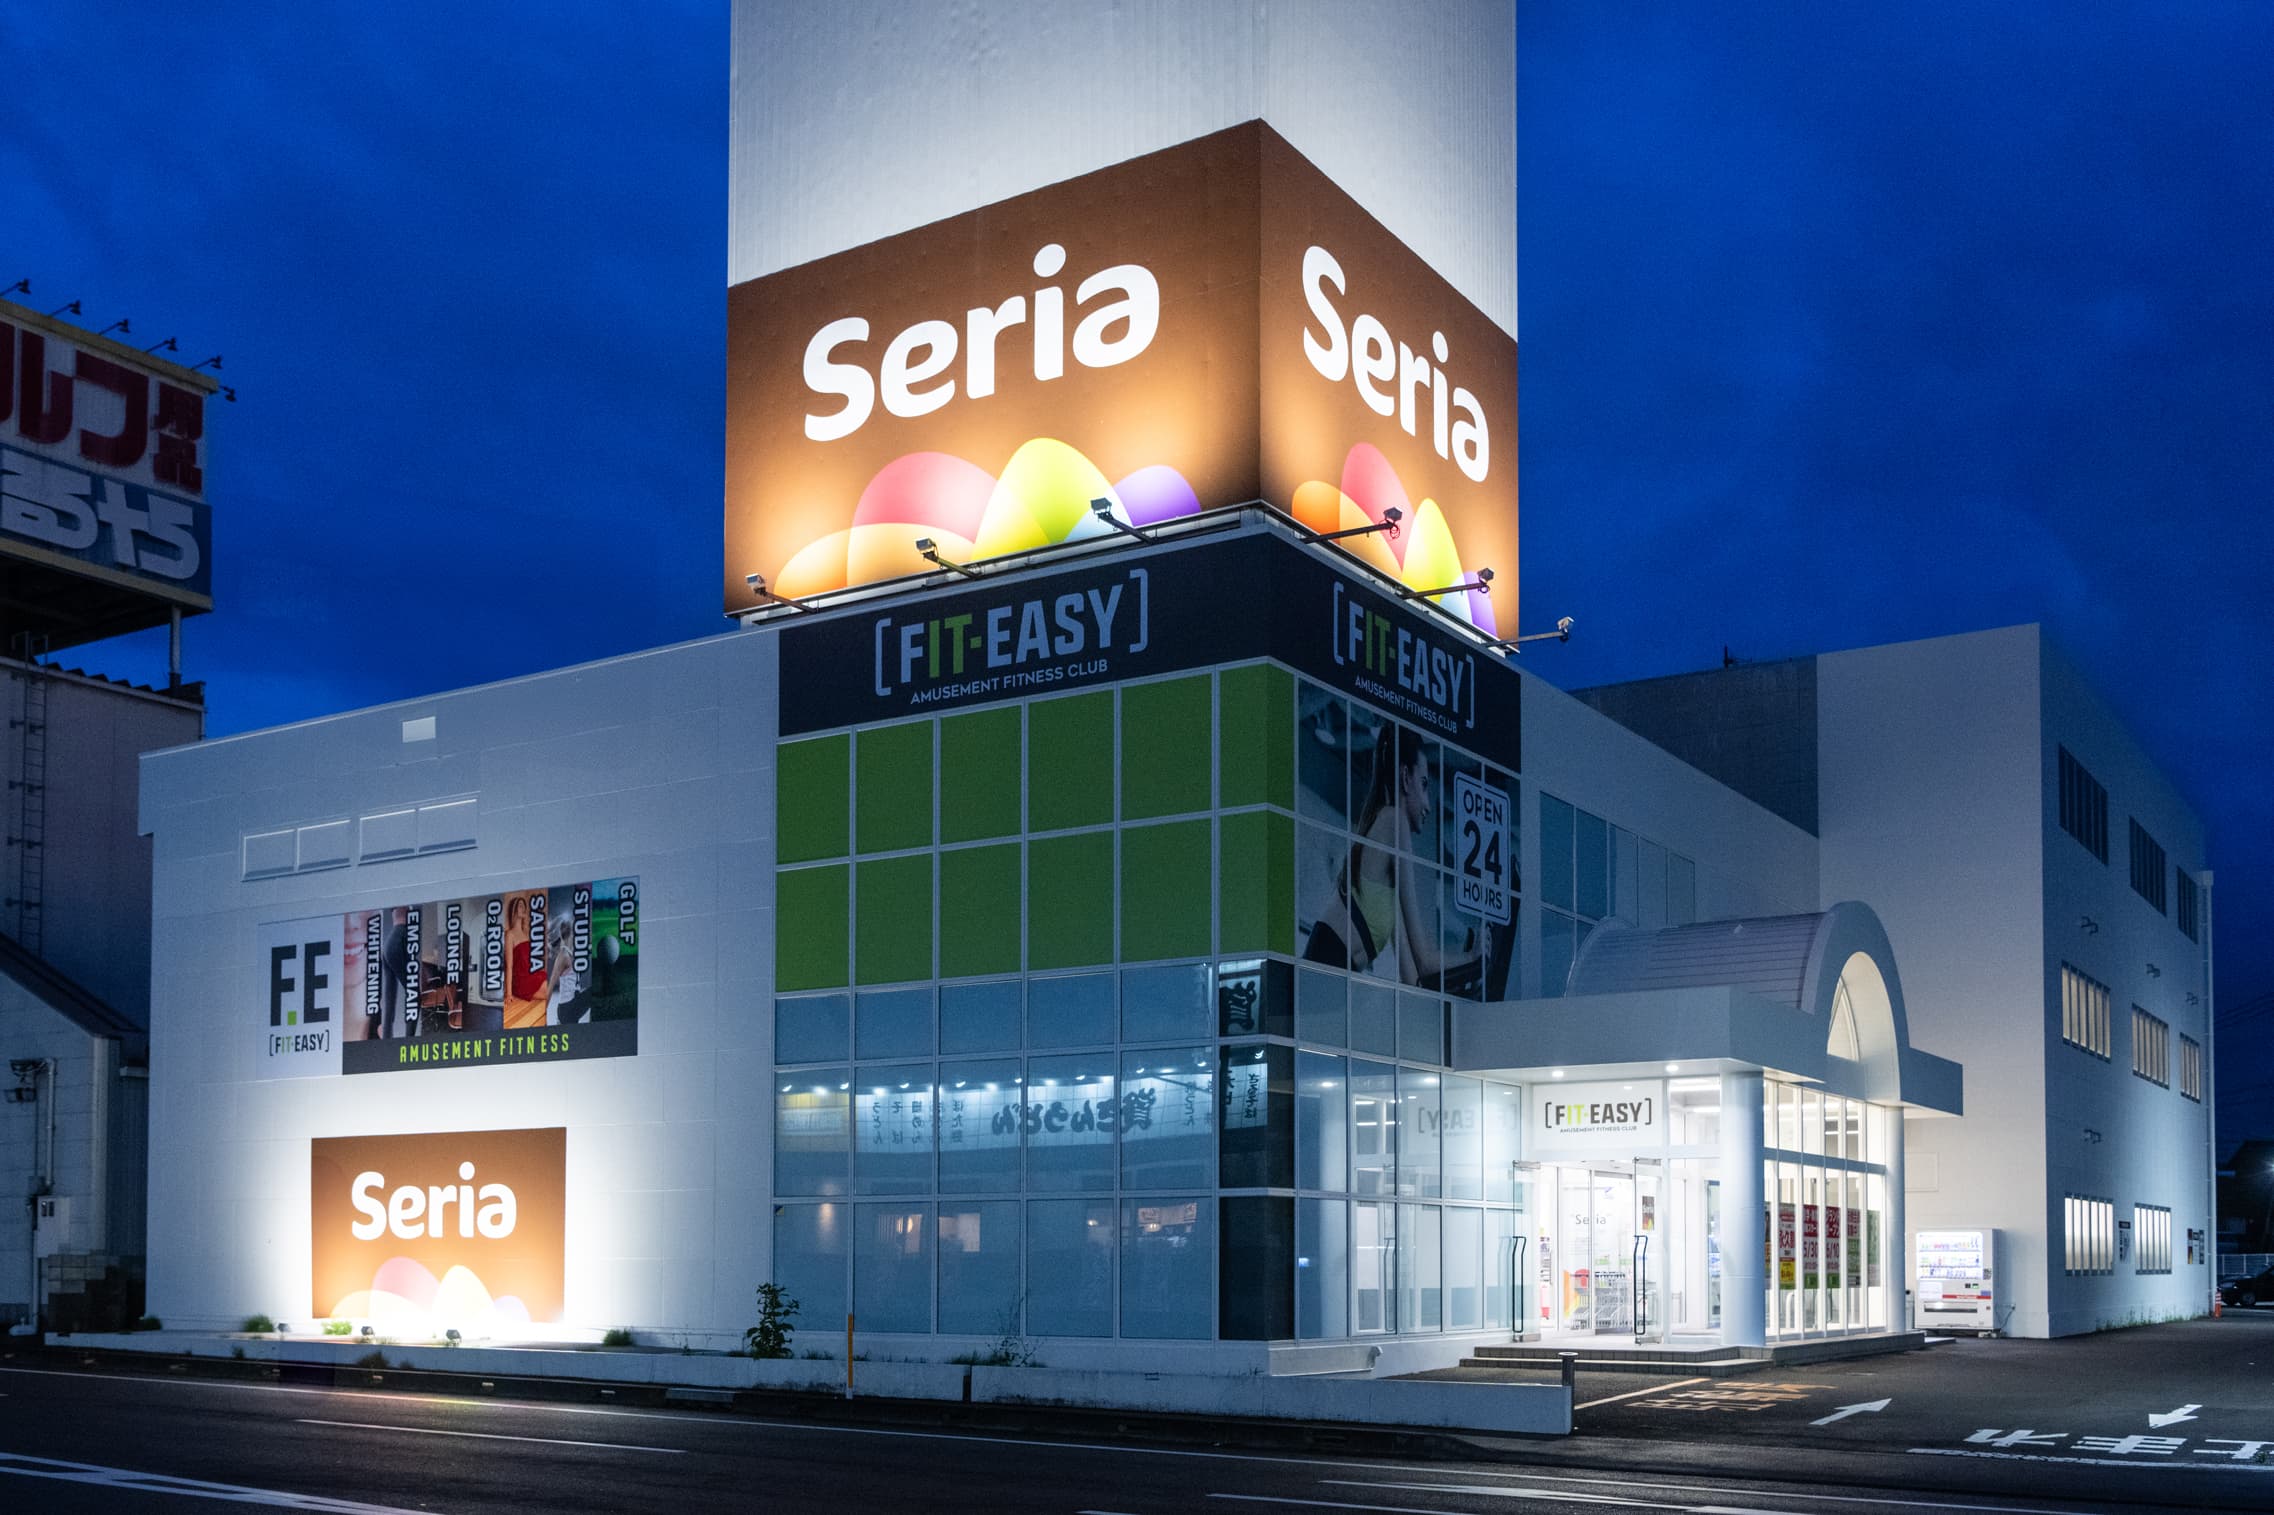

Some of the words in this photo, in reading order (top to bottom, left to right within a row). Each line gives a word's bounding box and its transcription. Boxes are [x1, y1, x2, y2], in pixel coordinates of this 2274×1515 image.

[803, 243, 1160, 441] Seria
[1302, 246, 1490, 482] Seria
[911, 677, 999, 704] AMUSEMENT
[1004, 666, 1063, 689] FITNESS
[1067, 659, 1108, 677] CLUB
[1355, 674, 1406, 708] AMUSEMENT
[1406, 699, 1437, 724] FITNESS
[1438, 714, 1457, 734] CLUB
[1463, 789, 1502, 825] OPEN
[1463, 820, 1502, 885] 24
[447, 904, 461, 985] LOUNGE
[529, 895, 545, 973] SAUNA
[573, 889, 589, 972] STUDIO
[619, 883, 636, 945] GOLF
[367, 915, 381, 1016] WHITENING
[406, 910, 420, 1022] EMS-CHAIR
[400, 1039, 492, 1063] AMUSEMENT
[500, 1034, 569, 1056] FITNESS
[1575, 1213, 1607, 1225] Seia
